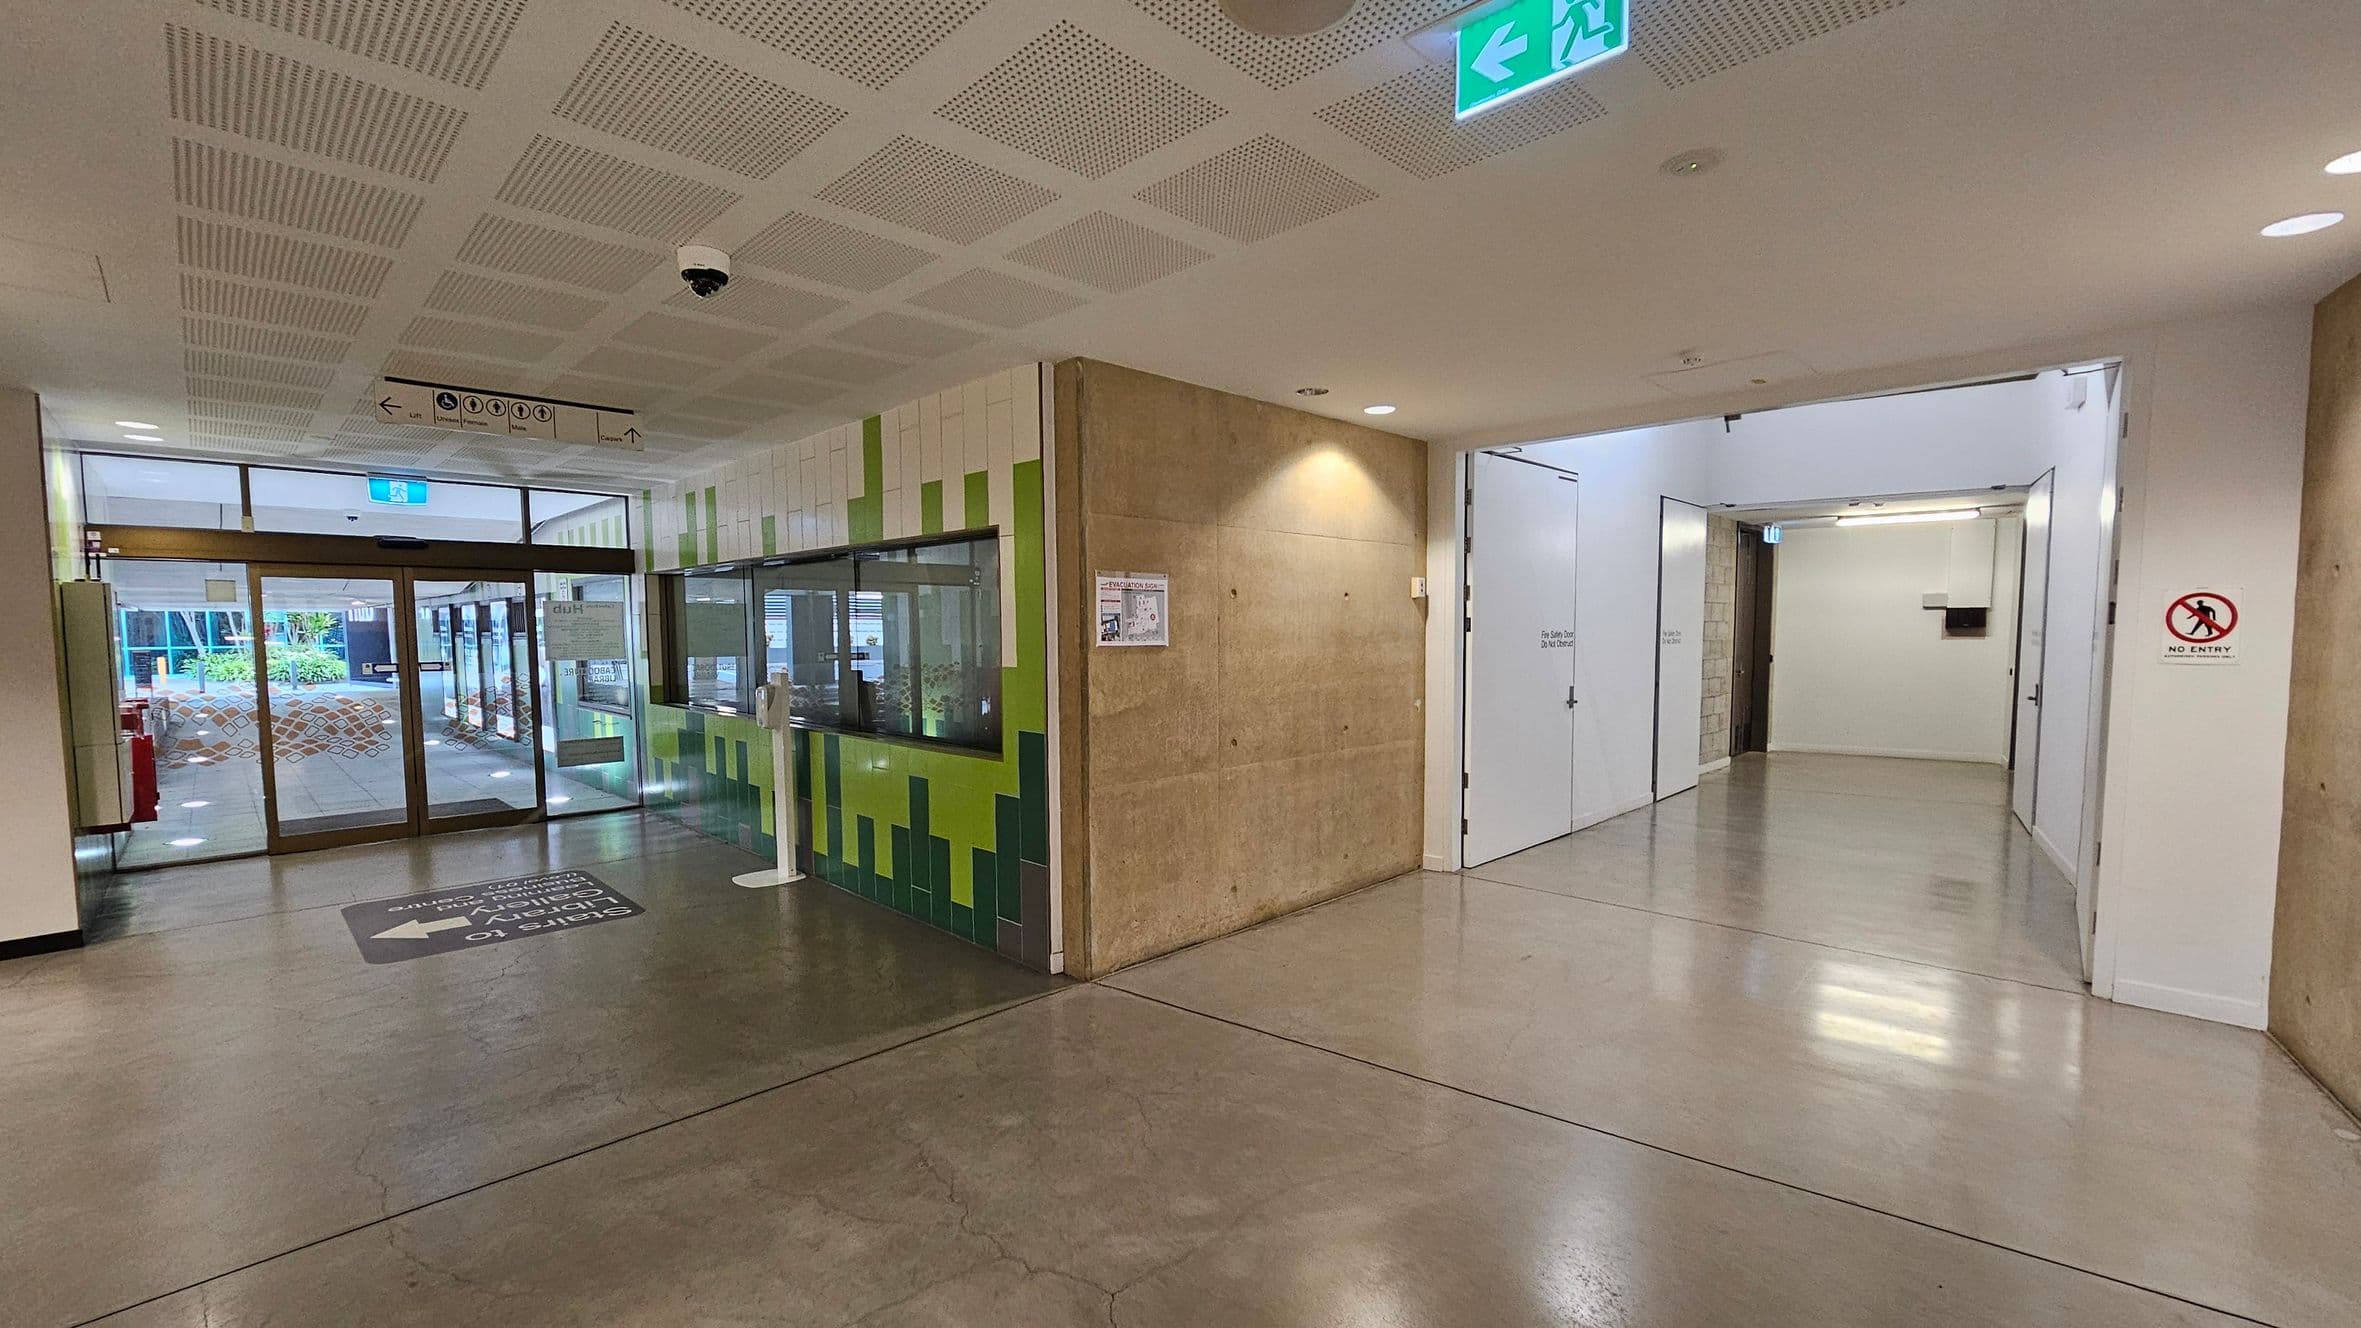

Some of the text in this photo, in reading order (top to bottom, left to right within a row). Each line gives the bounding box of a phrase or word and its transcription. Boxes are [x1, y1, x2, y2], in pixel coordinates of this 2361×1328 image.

[1108, 581, 1144, 589] EVACUATION
[388, 876, 587, 912] Business Centre
[437, 881, 594, 912] Learning and
[470, 888, 603, 916] Gallery
[465, 906, 632, 941] Stairs to
[485, 896, 619, 925] Library
